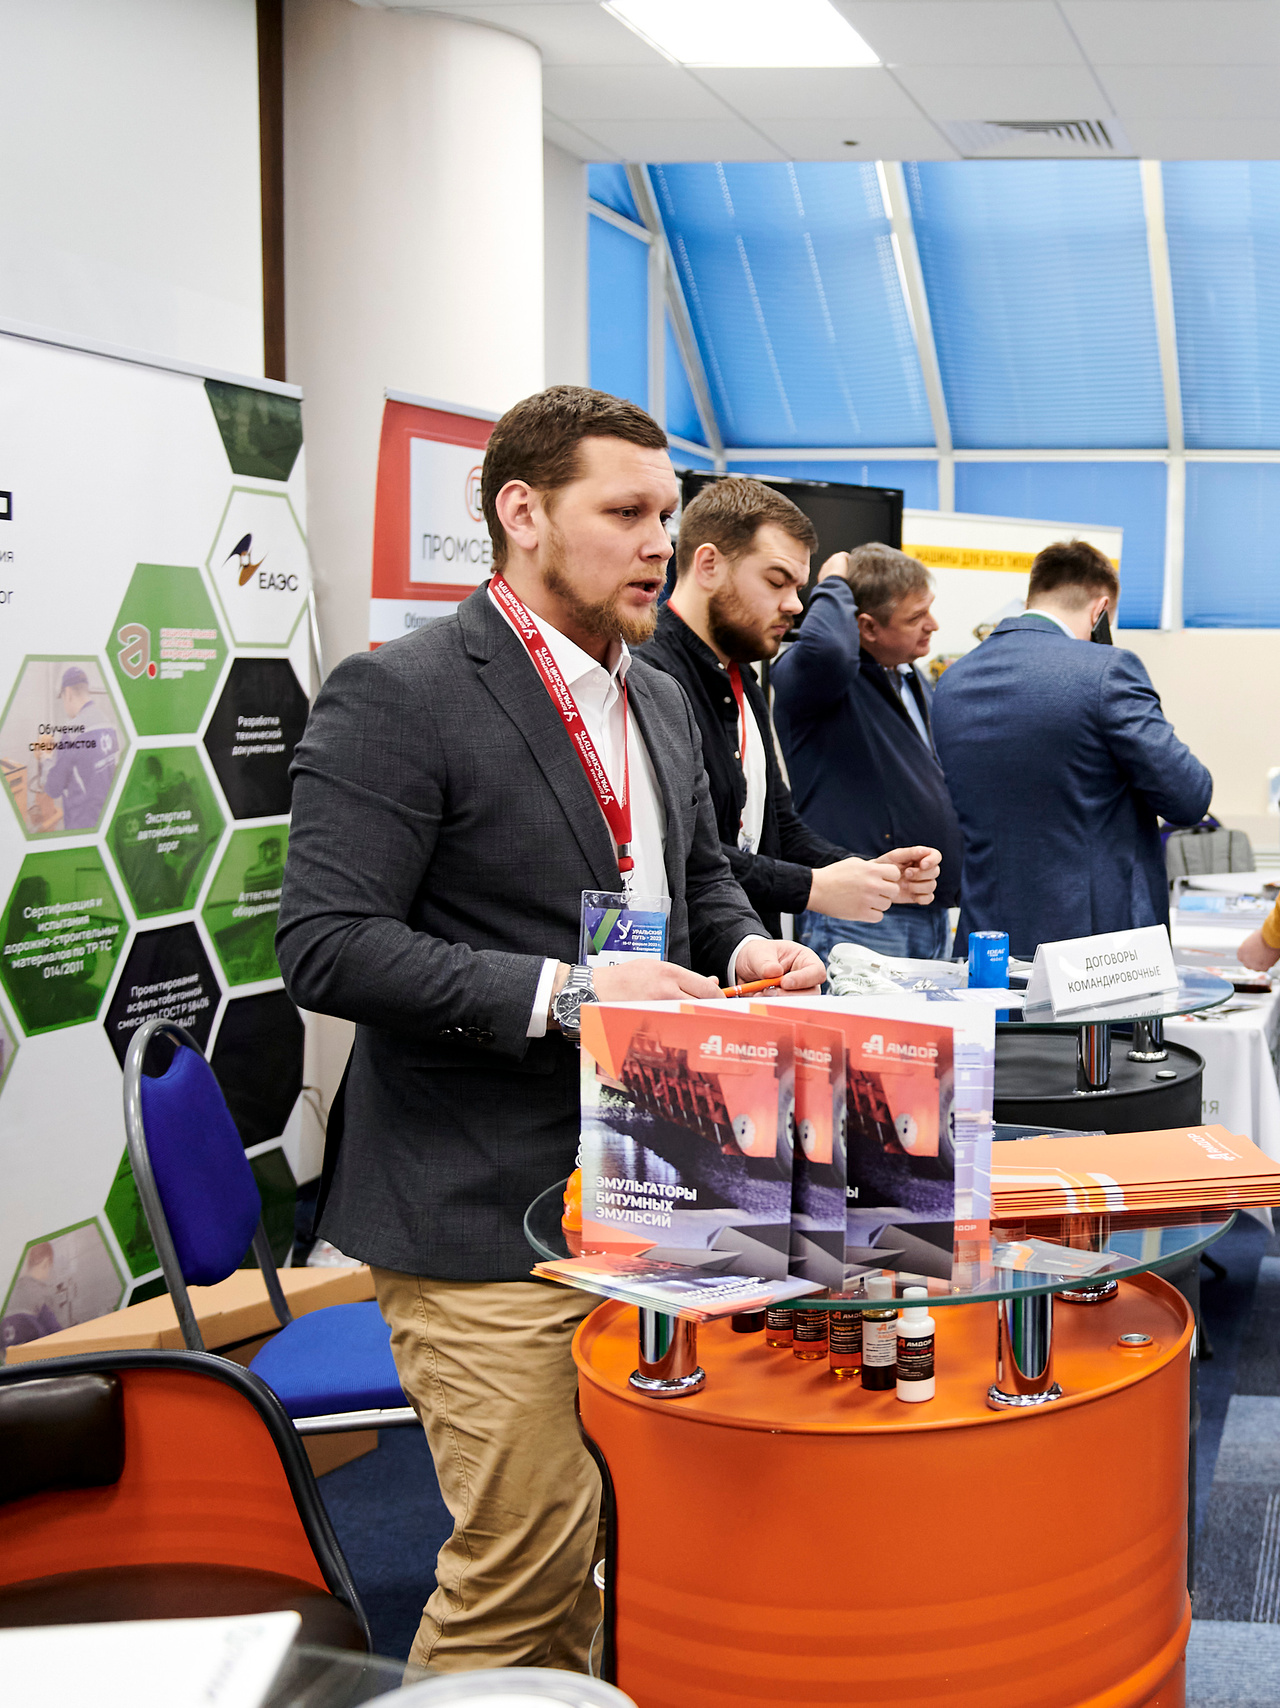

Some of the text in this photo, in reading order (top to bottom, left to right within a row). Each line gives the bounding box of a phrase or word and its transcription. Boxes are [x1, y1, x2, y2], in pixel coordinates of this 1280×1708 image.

[422, 534, 492, 564] ПРОМСЕ
[259, 572, 298, 591] ЕАЭС
[507, 592, 533, 627] УРАЛЬСКИЙ
[541, 646, 574, 710] УРАЛЬСКИЙ ПУТЬ
[553, 685, 568, 710] ДОРОЖНАЯ
[38, 724, 85, 737] Обучение
[29, 740, 97, 752] специалистов
[580, 730, 611, 793] УРАЛЬСКИЙ ПУТЬ
[590, 768, 605, 794] ДОРОЖНАЯ
[145, 810, 191, 825] Экспертиза
[137, 824, 199, 841] автомобильных
[157, 840, 180, 854] дорог
[238, 887, 282, 902] Аттестаци
[23, 899, 95, 919] Сертификация
[37, 914, 90, 932] испытания
[3, 925, 119, 955] дорожно-строительных
[12, 939, 113, 969] материалов по ТР ТС
[1085, 949, 1138, 971] ДОГОВОРЫ
[43, 960, 84, 979] 014/2011
[1068, 965, 1161, 993] КОМАНДИРОВОЧНЫЕ
[131, 973, 199, 998] Проектирование
[127, 984, 203, 1014] асфальтобетонной
[117, 1015, 145, 1030] смеси
[159, 1004, 180, 1019] ГОСТ
[725, 1043, 778, 1058] АМДОР
[886, 1043, 938, 1059] АМДОР
[595, 1176, 697, 1201] ЭМУЛЬГАТОРЫ
[596, 1191, 674, 1213] БИТУМНЫХ
[595, 1206, 671, 1228] ЭМУЛЬСИЙ
[906, 1339, 932, 1347] АМДОР
